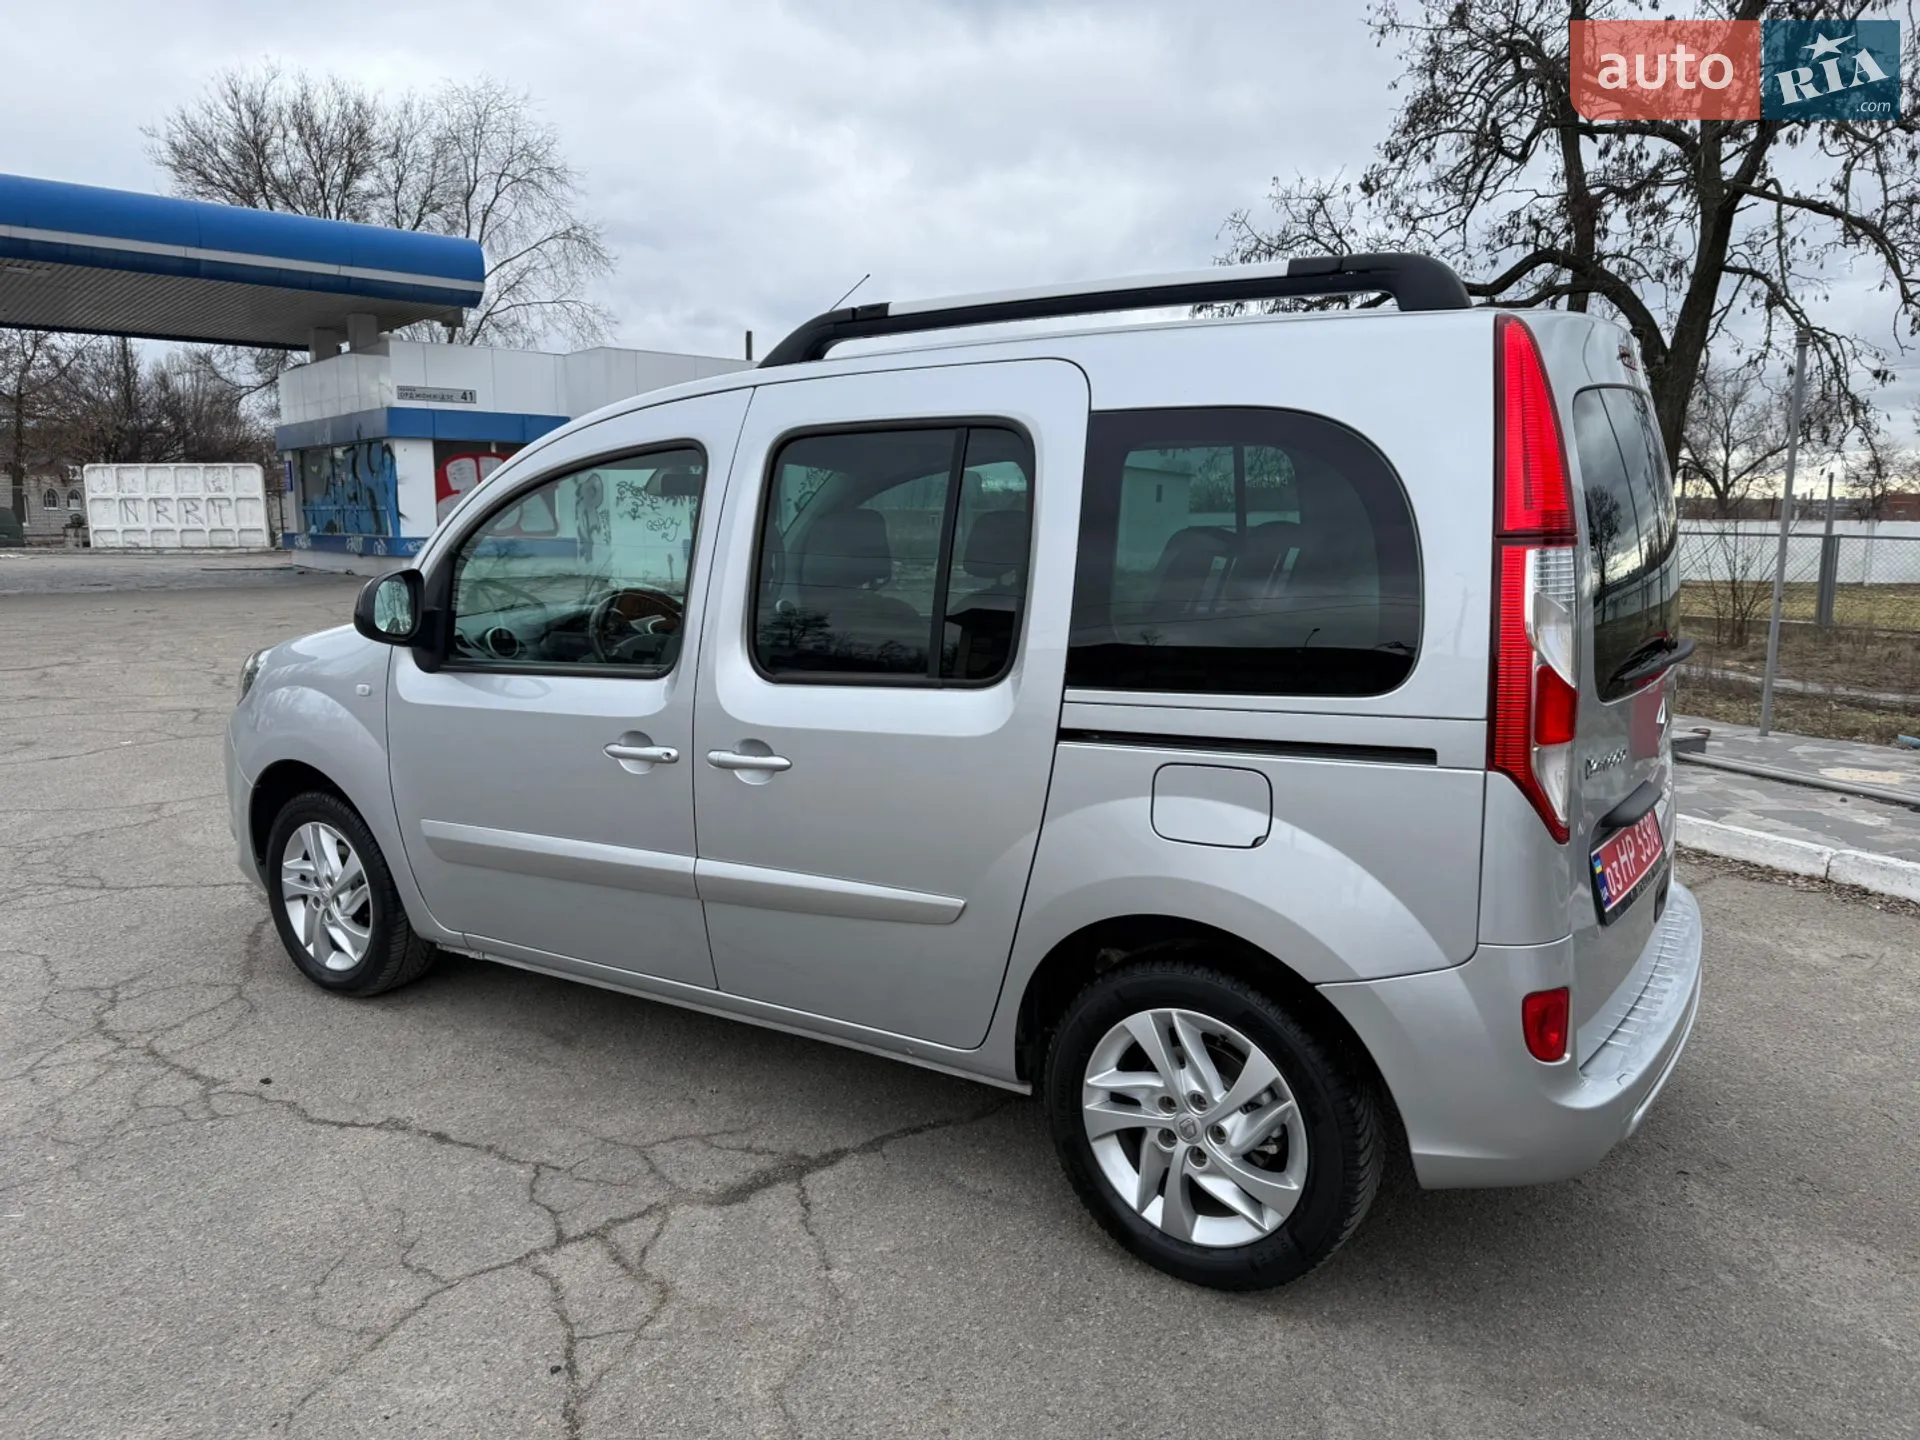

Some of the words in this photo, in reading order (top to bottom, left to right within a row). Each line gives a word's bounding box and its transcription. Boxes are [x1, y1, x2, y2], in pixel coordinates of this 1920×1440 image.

[460, 391, 474, 401] 41
[1606, 861, 1623, 896] 03
[1616, 834, 1636, 882] HP
